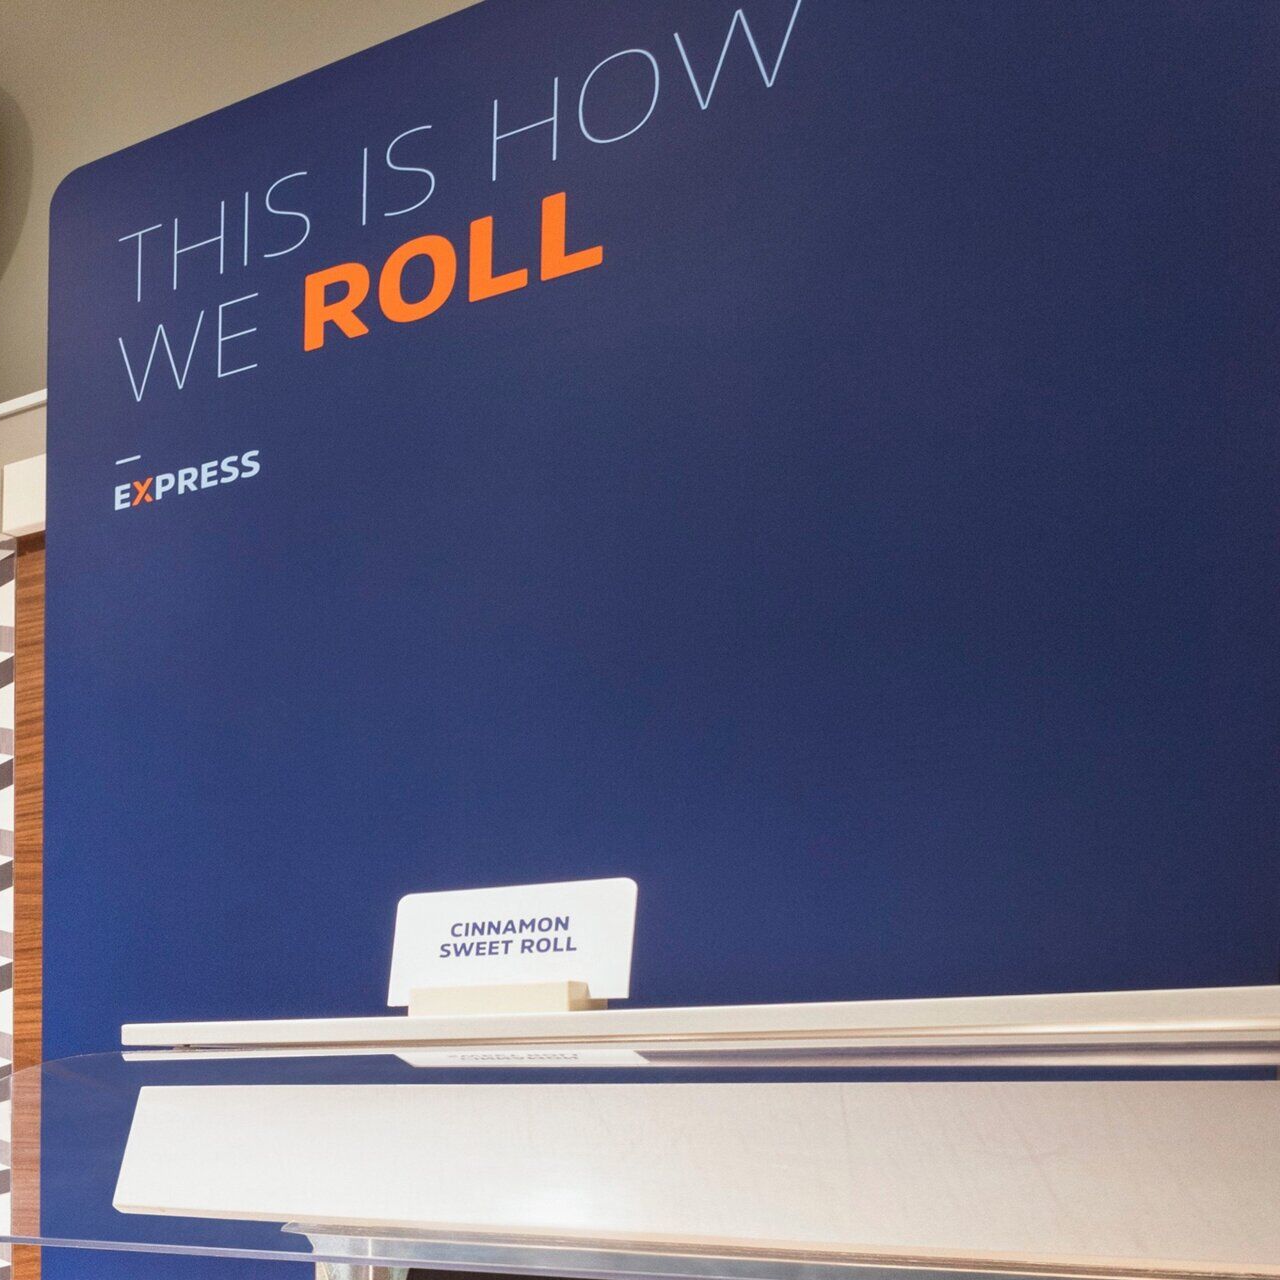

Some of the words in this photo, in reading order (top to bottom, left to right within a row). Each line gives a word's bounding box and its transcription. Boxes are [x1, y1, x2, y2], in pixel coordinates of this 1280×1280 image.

[118, 171, 310, 303] THIS
[360, 124, 436, 227] IS
[490, 0, 802, 182] HOW
[118, 292, 259, 403] WE
[303, 190, 604, 352] ROLL
[114, 449, 261, 511] EXPRESS
[439, 939, 514, 959] SWEET
[520, 936, 578, 954] ROLL
[450, 915, 571, 938] CINNAMON
